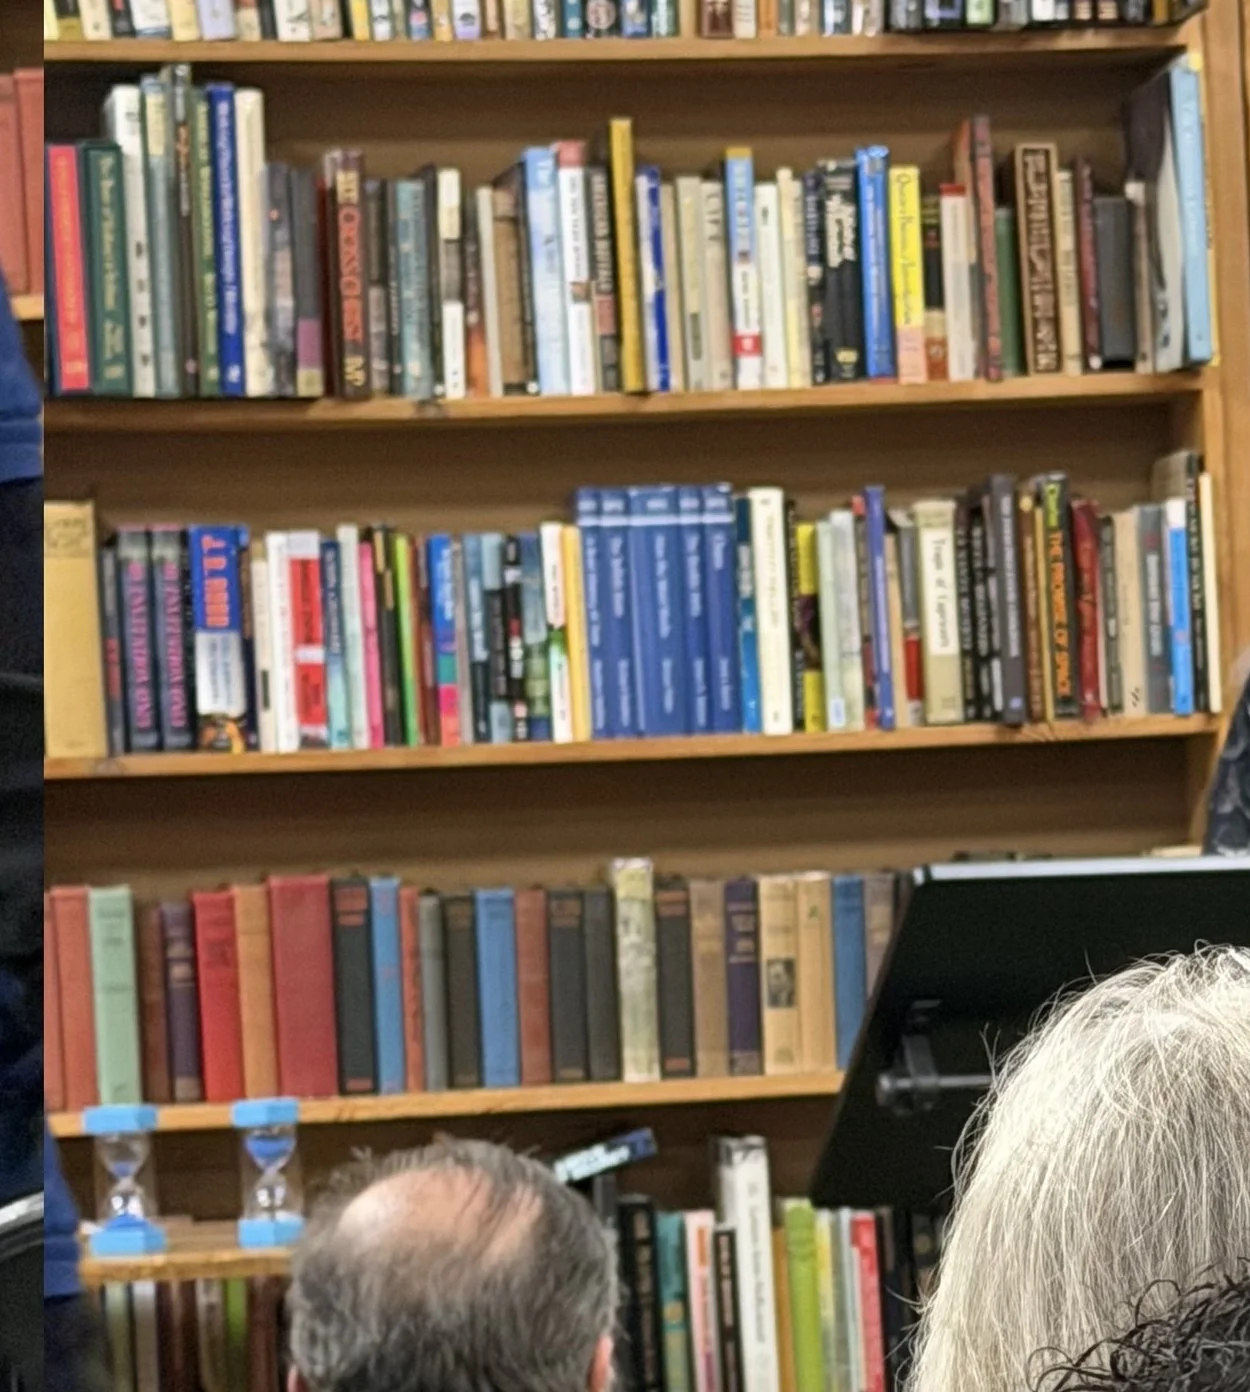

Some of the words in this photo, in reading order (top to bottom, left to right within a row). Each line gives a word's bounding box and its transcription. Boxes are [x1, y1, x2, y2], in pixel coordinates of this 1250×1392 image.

[1049, 531, 1064, 560] THE
[1050, 562, 1067, 625] PROMISE
[1055, 628, 1069, 647] OF
[1056, 651, 1072, 697] SPACE
